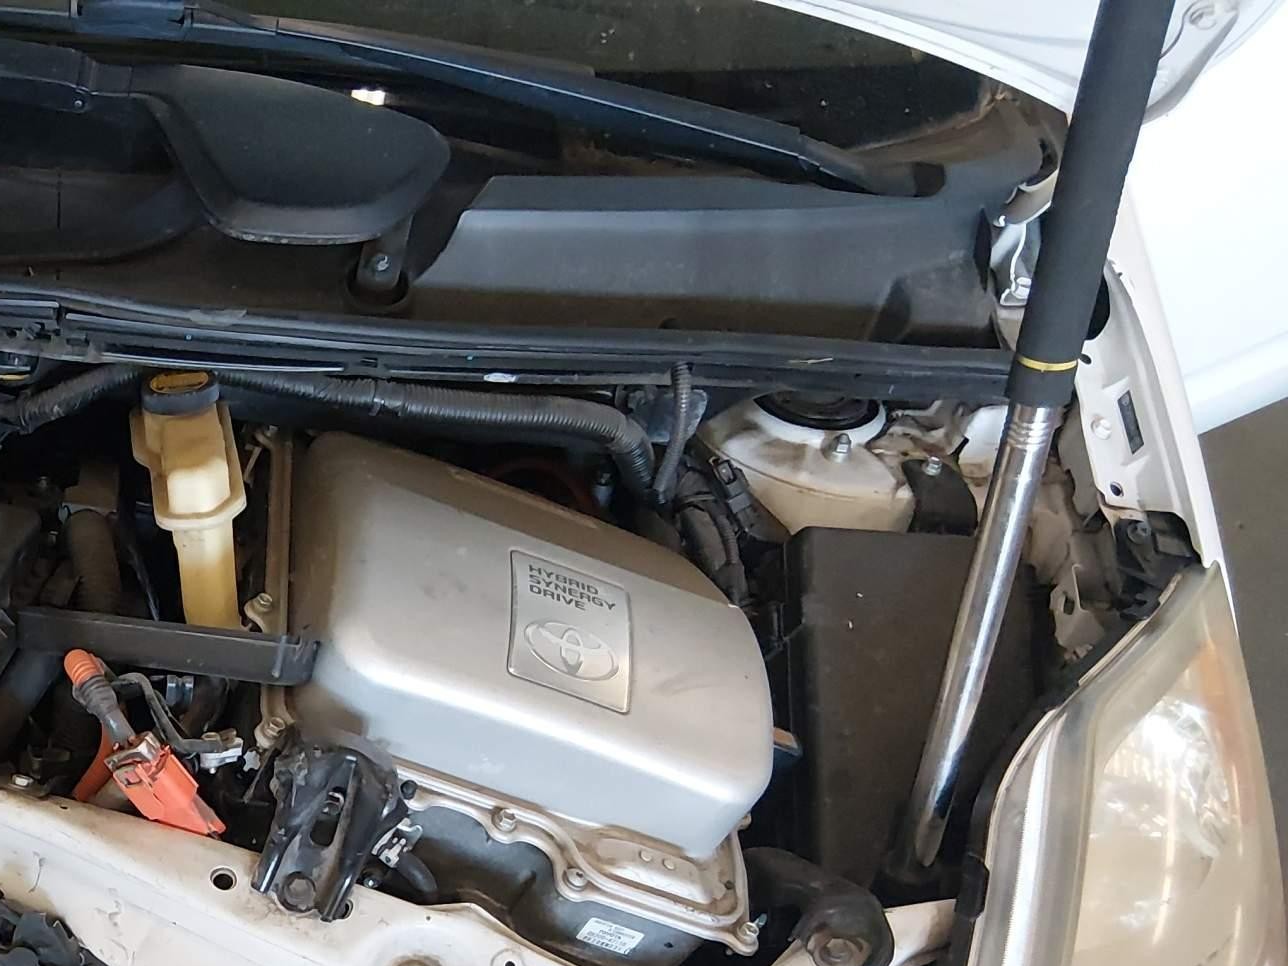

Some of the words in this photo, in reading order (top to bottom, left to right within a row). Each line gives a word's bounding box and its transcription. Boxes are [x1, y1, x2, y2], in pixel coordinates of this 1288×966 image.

[528, 564, 599, 595] HYBRID
[529, 574, 616, 610] SYNERGY
[529, 584, 586, 611] DRIVE
